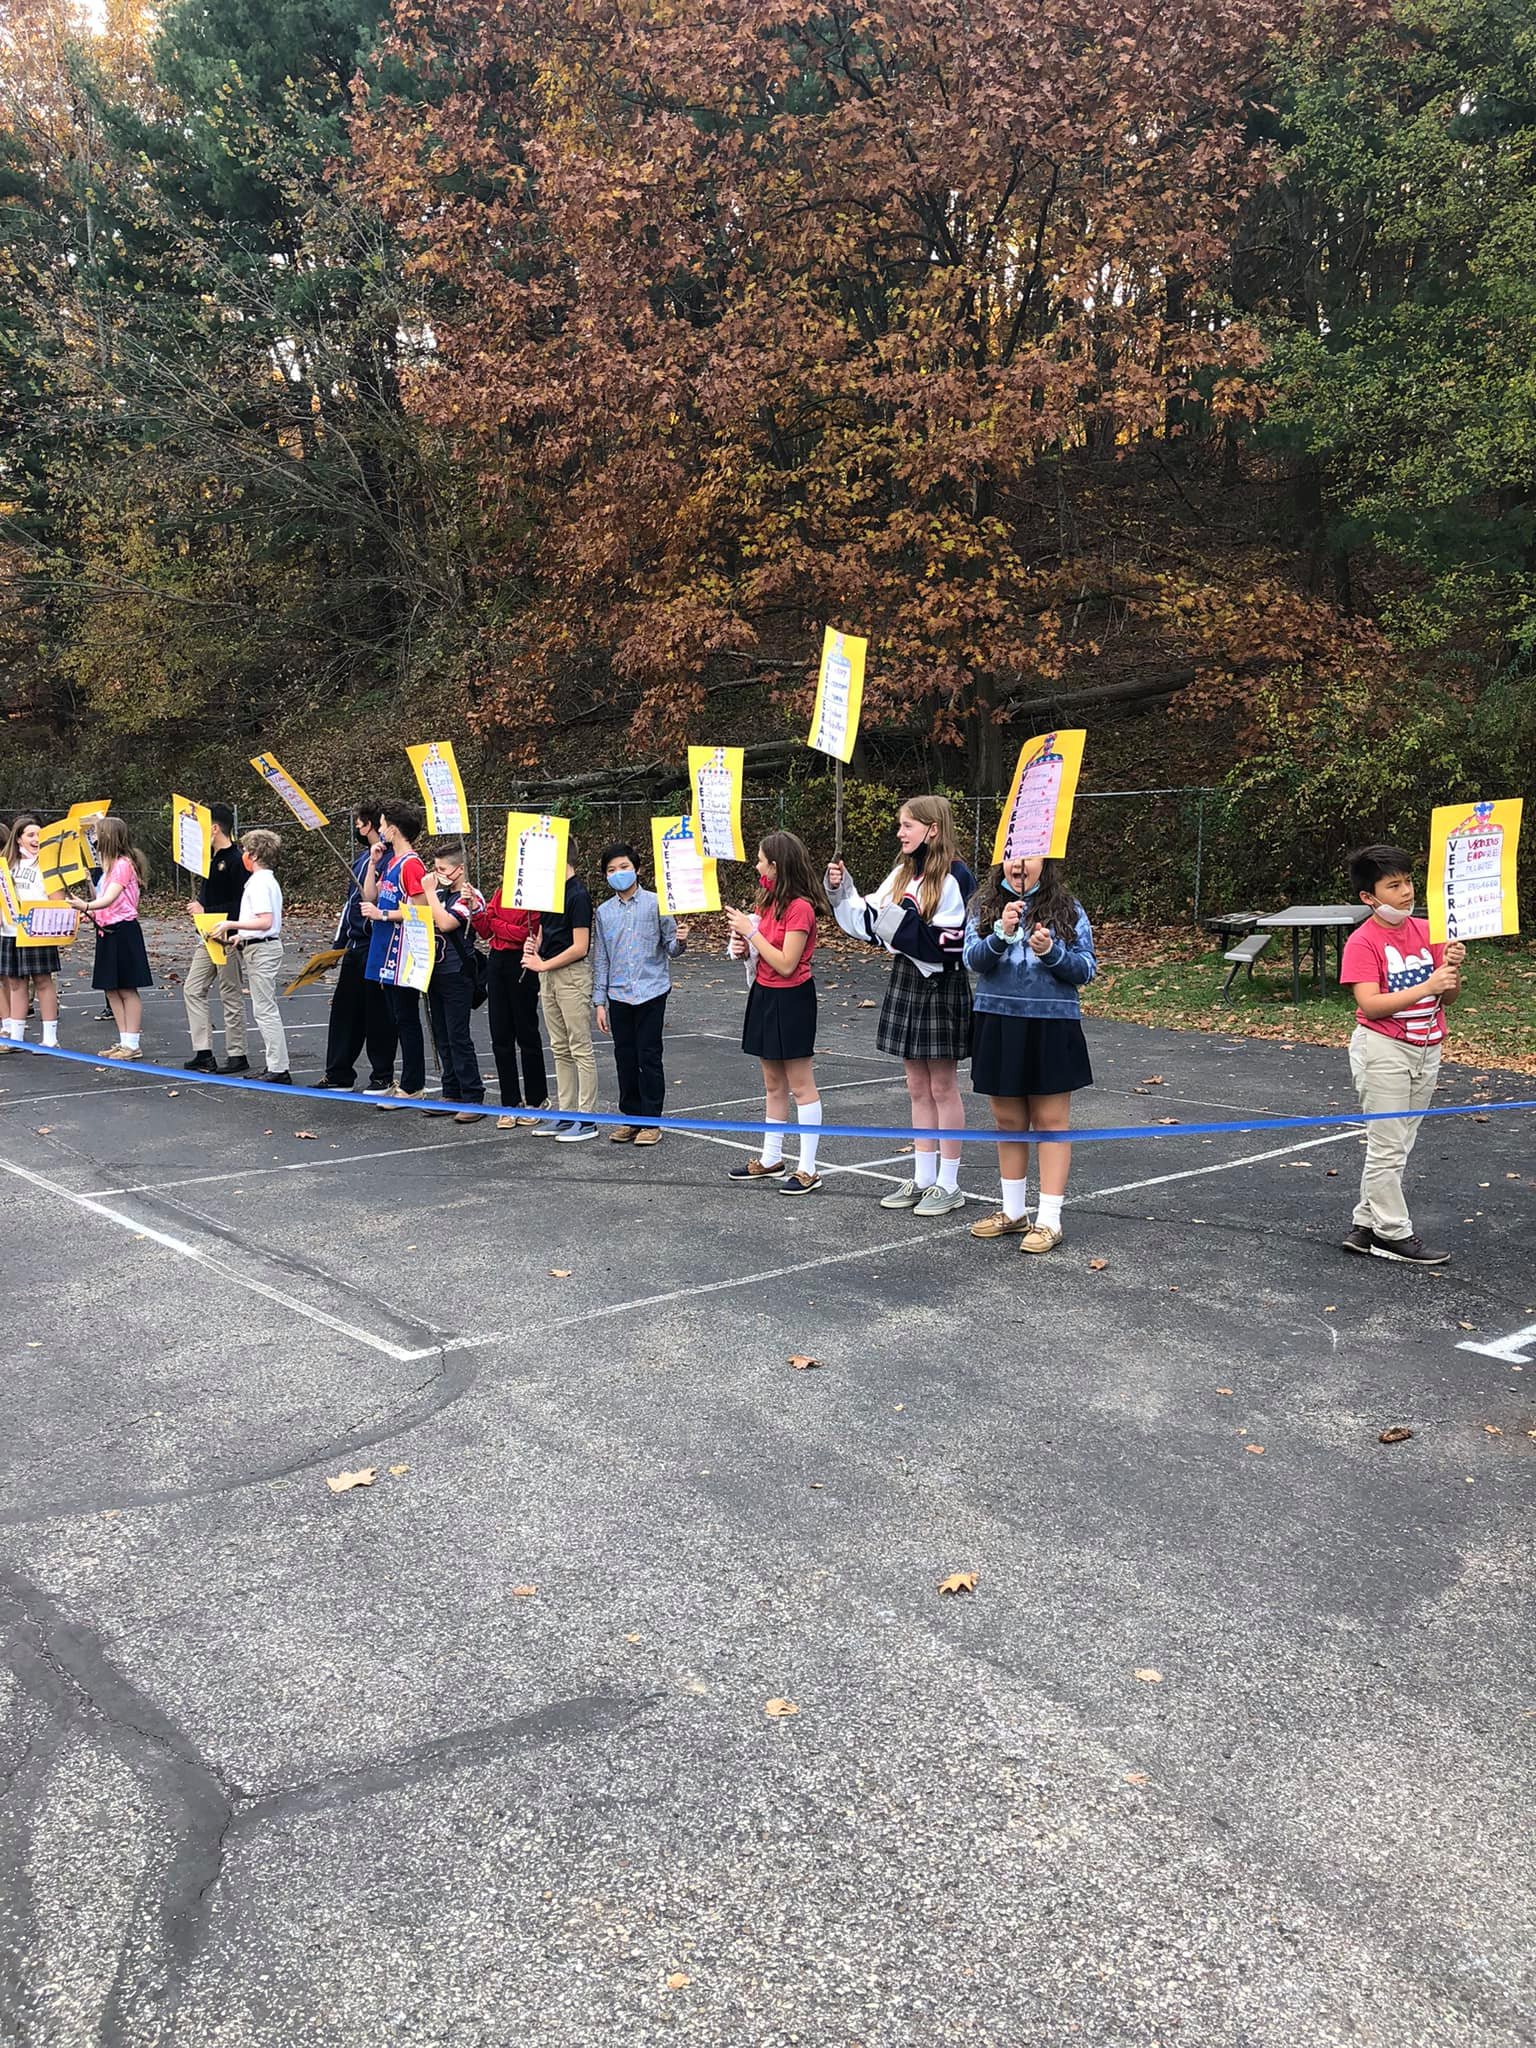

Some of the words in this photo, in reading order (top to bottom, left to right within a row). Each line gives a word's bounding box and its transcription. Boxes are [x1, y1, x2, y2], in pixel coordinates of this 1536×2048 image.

[698, 776, 711, 857] VETERAN
[1003, 771, 1028, 861] VETERAN
[514, 837, 528, 907] VETERAN
[662, 841, 677, 911] VETERAN
[1446, 840, 1459, 939] VETERAN
